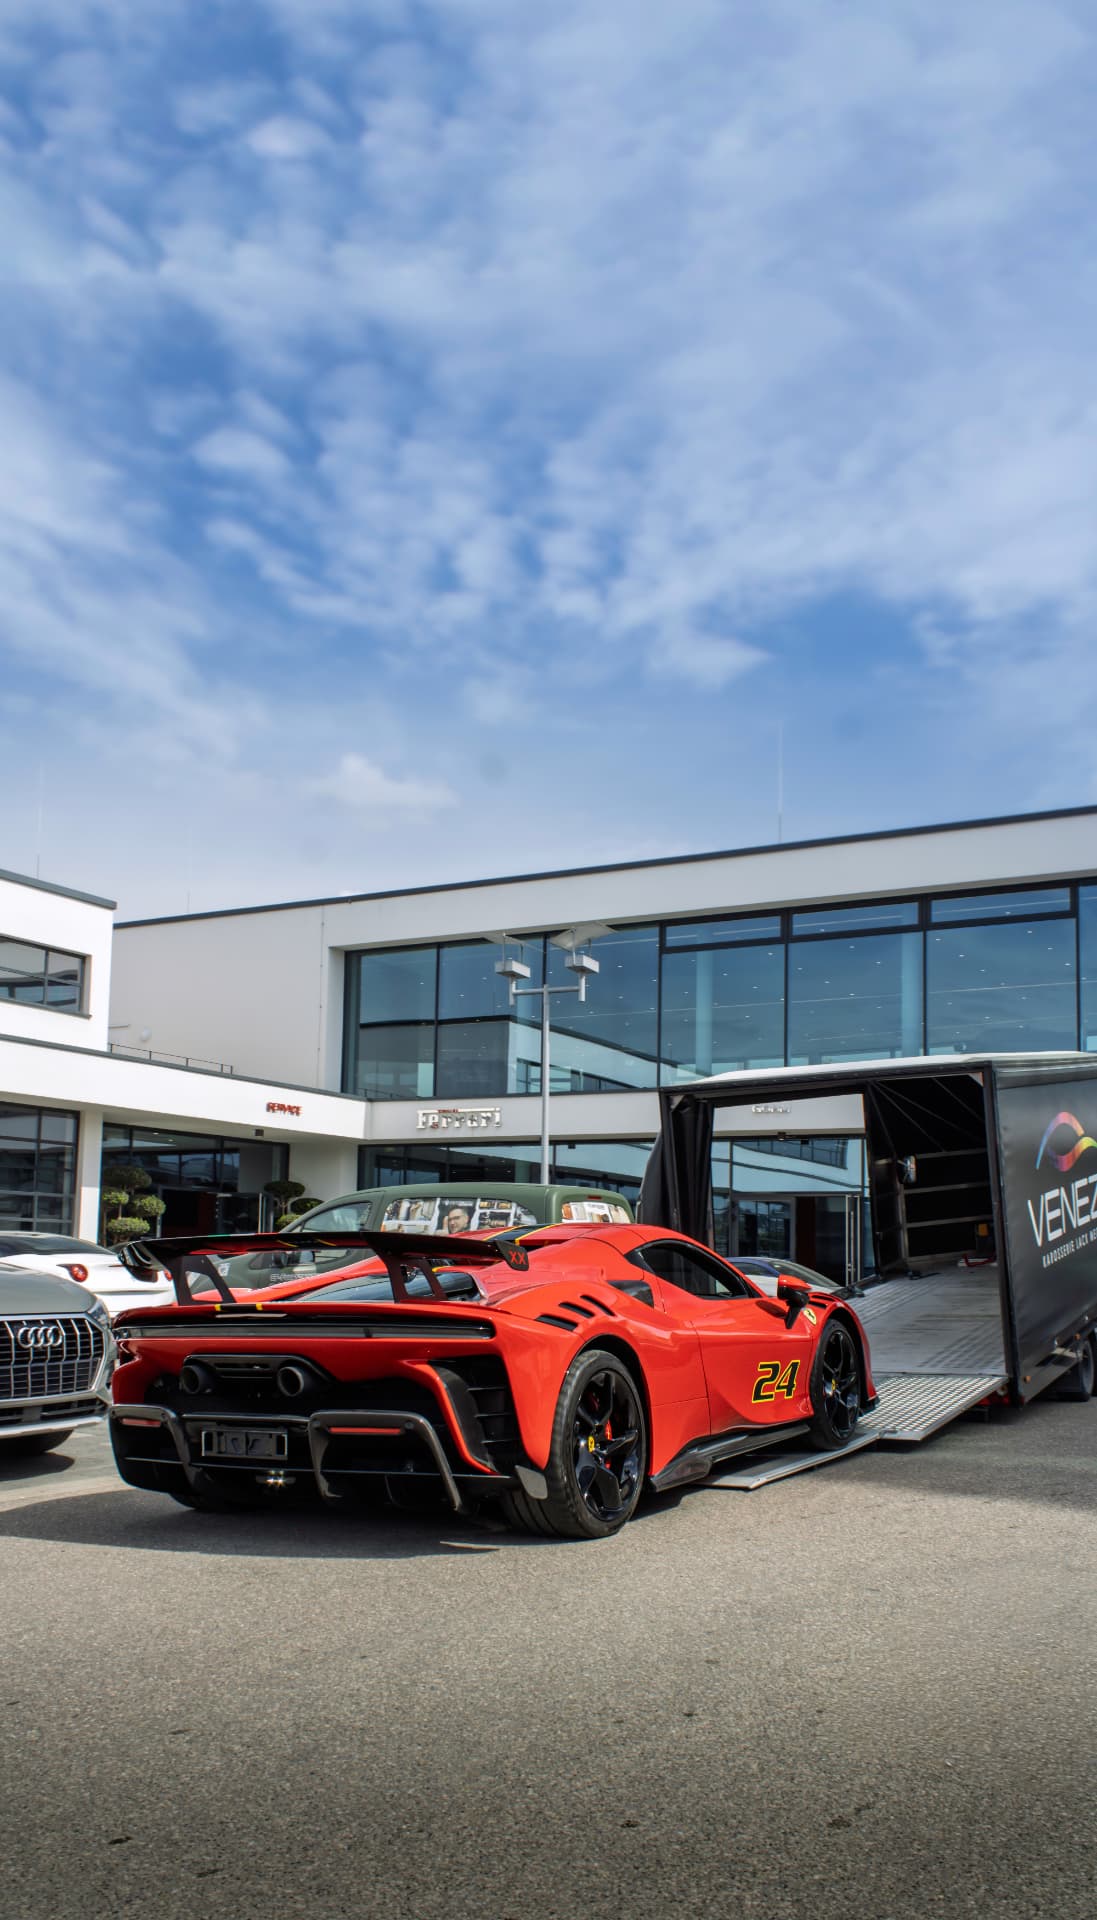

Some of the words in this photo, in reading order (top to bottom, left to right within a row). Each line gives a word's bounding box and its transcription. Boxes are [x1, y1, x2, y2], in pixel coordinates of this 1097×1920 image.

[416, 1106, 501, 1130] Ferrari
[509, 1250, 527, 1265] XX
[751, 1359, 801, 1404] 24
